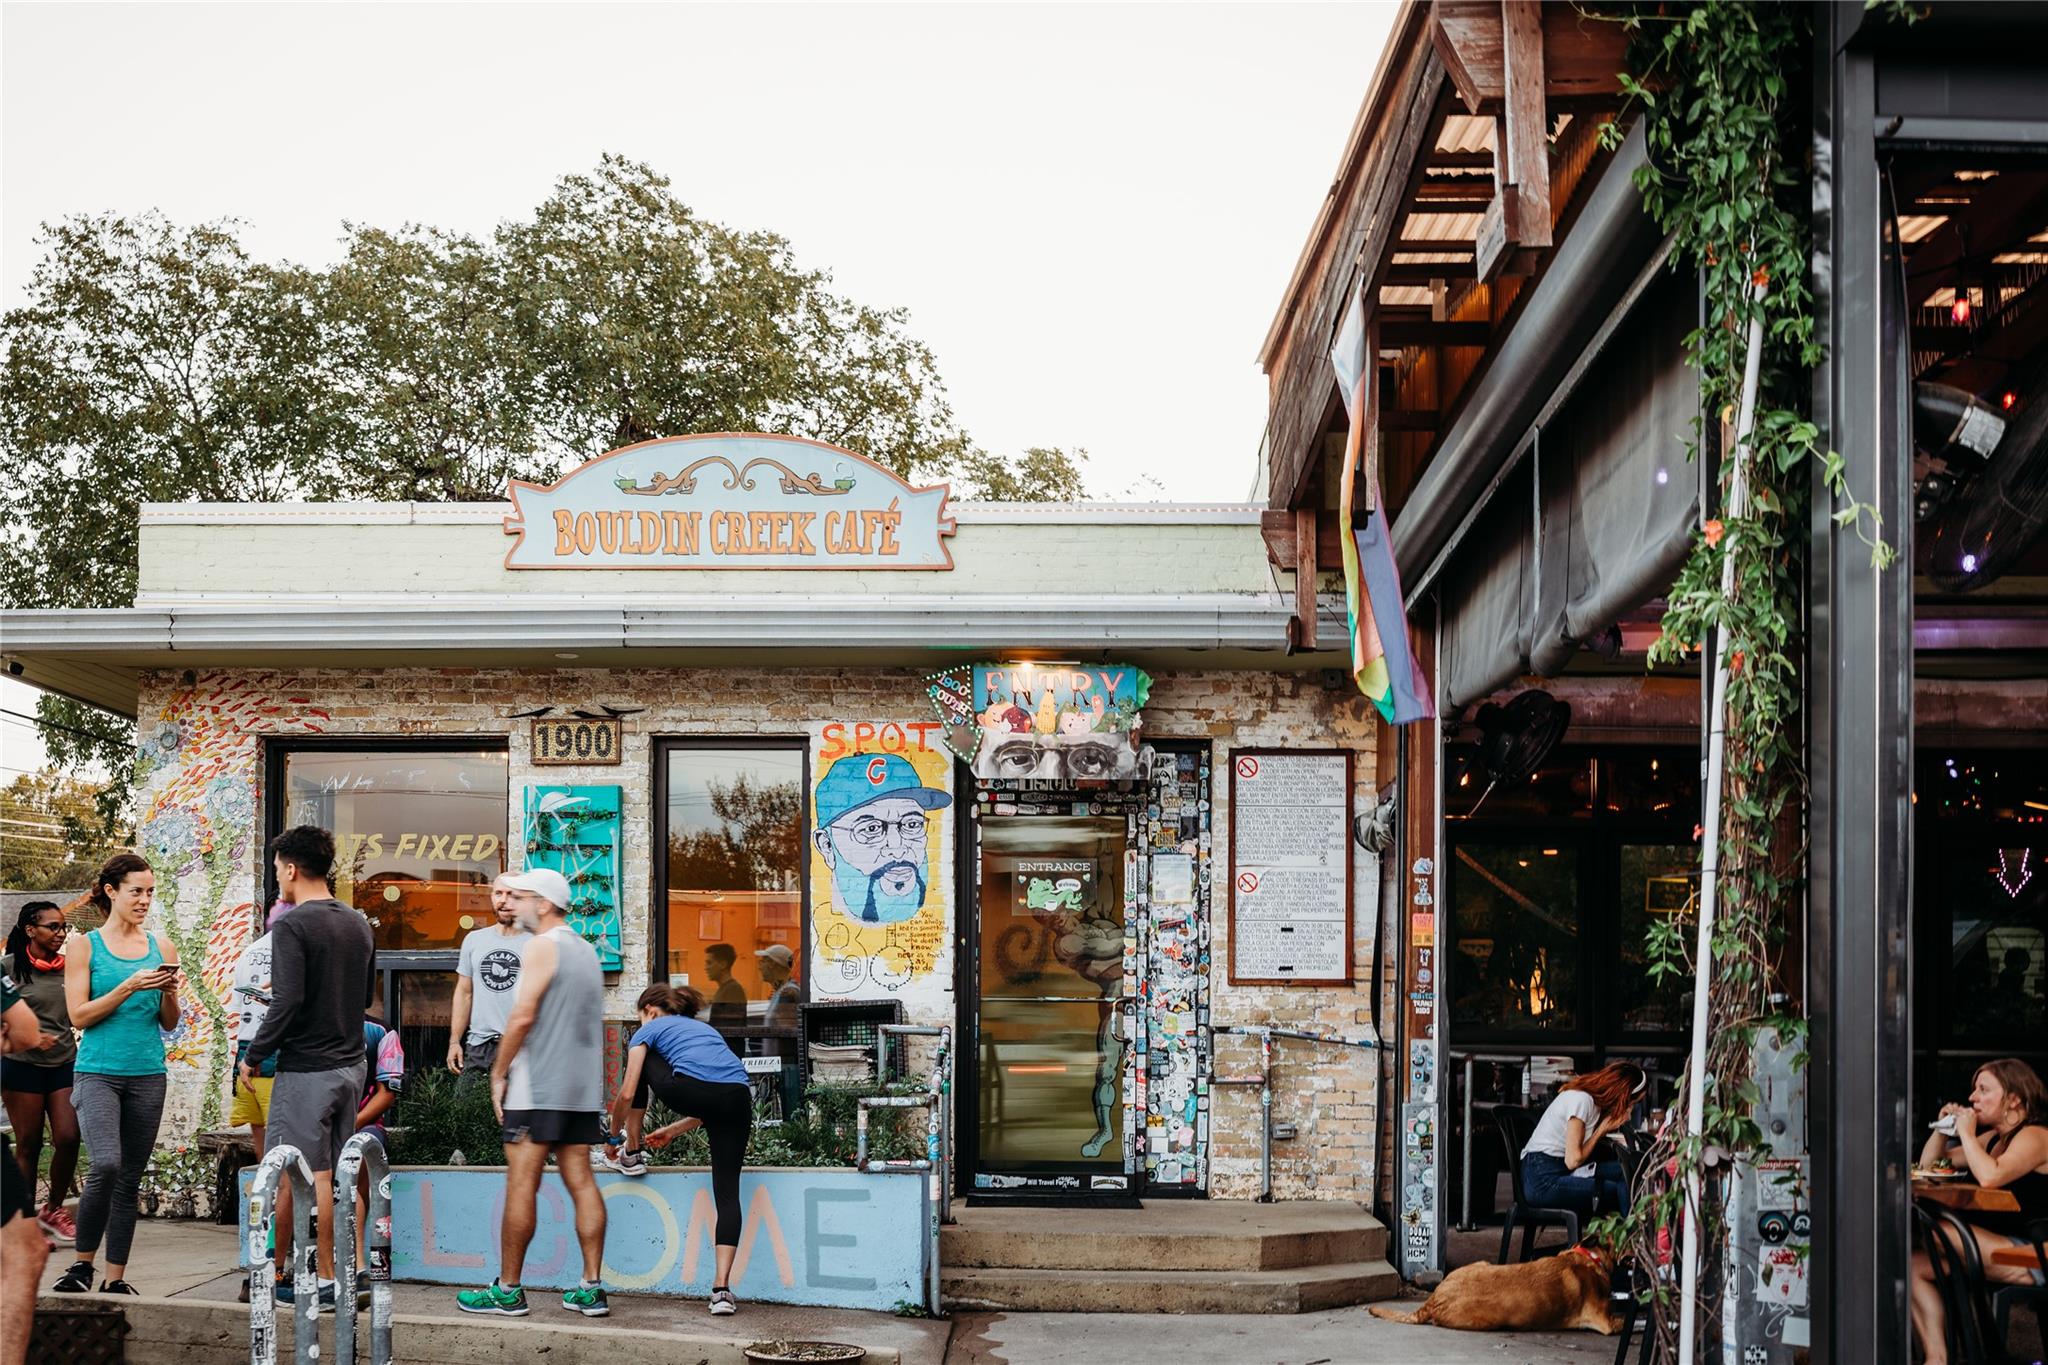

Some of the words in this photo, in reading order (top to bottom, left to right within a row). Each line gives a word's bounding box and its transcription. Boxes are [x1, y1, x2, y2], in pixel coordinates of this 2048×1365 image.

[552, 510, 700, 555] BOULDIN
[709, 510, 816, 554] CREEK
[825, 495, 901, 555] CAFÉ
[937, 673, 968, 696] 1900
[985, 671, 1124, 707] ENTRY
[930, 684, 972, 716] SOUTH
[537, 724, 612, 758] 1900
[394, 833, 498, 862] FIXED
[1018, 862, 1091, 872] ENTRANCE
[921, 910, 933, 918] You
[489, 952, 516, 963] PLANT
[484, 974, 516, 990] POWERED
